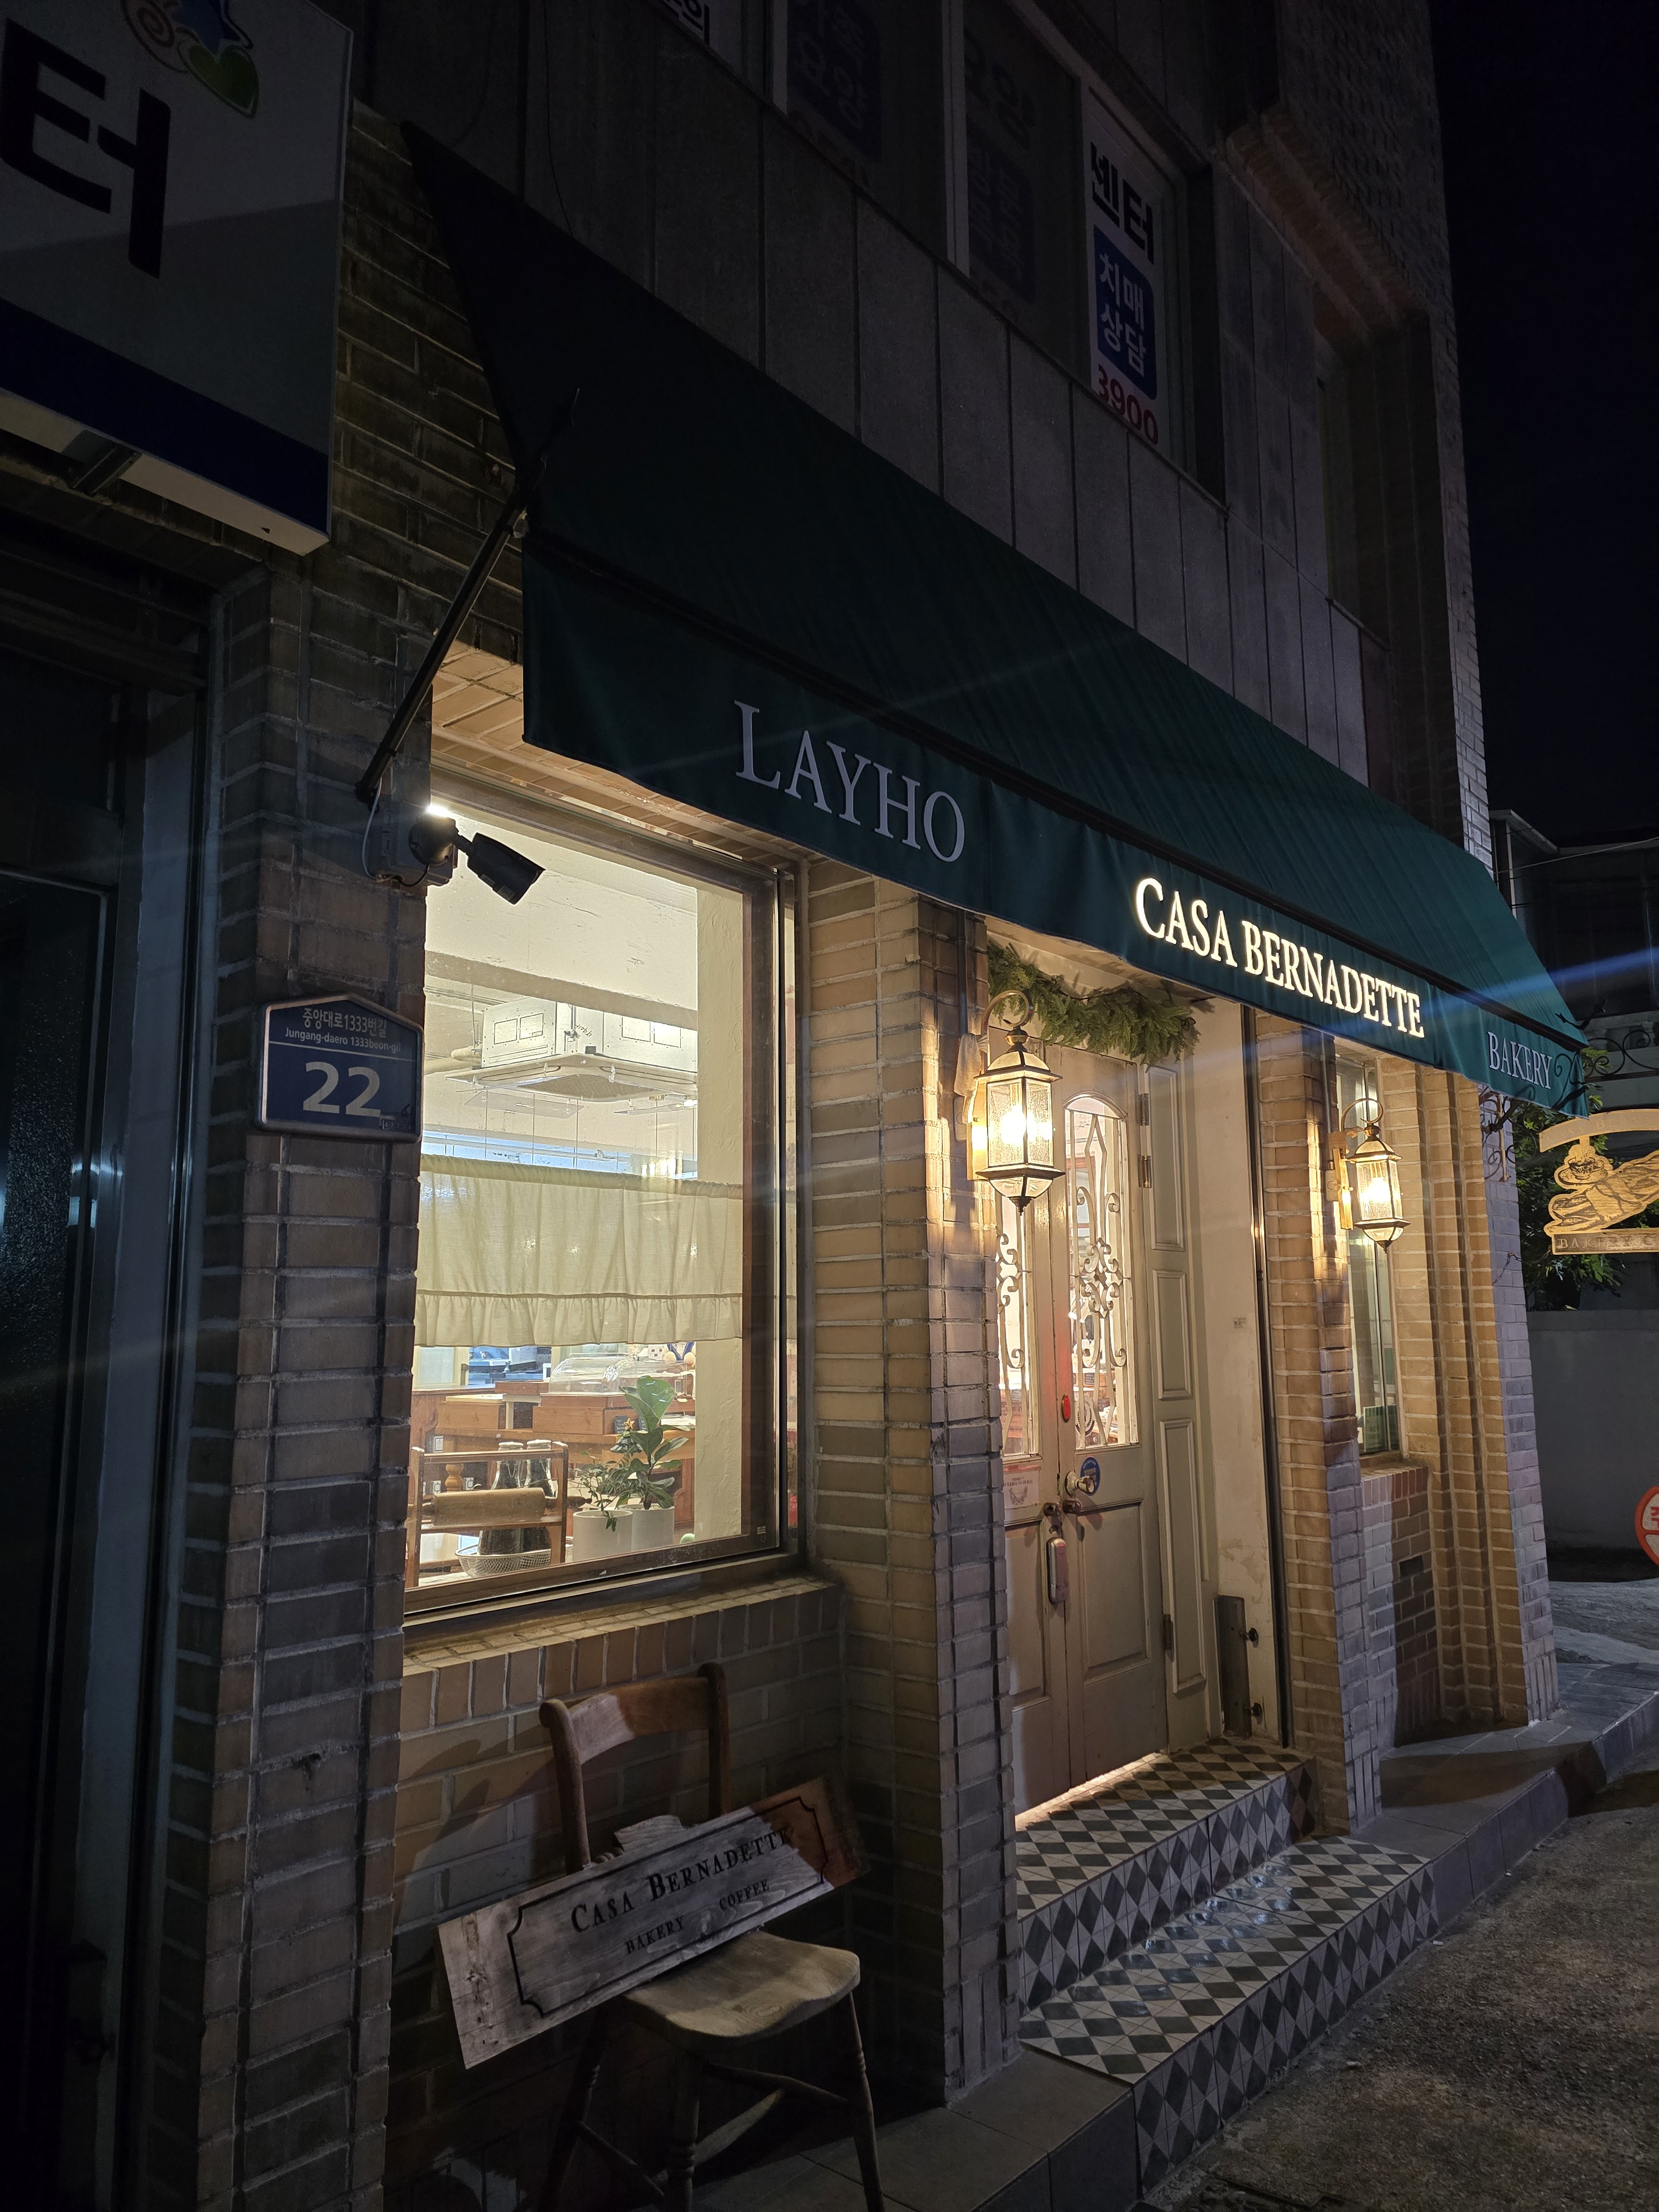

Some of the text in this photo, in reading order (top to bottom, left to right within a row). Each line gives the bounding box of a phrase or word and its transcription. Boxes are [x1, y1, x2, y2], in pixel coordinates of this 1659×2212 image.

[1091, 142, 1154, 265] 센터
[1099, 253, 1145, 332] 치매
[1102, 304, 1145, 378] 상담
[1098, 364, 1158, 445] 3900
[734, 700, 964, 862] LAYHO
[1136, 878, 1425, 1038] CASA BERNADETTE
[285, 1027, 401, 1053] Jungang-daero 1333beon-gil
[302, 1008, 386, 1038] 중앙대로1333번길
[1487, 1031, 1552, 1089] BAKERY
[302, 1061, 381, 1117] 22
[571, 1891, 635, 1933] CASA
[626, 1879, 770, 1955] BAKERY COFFEE
